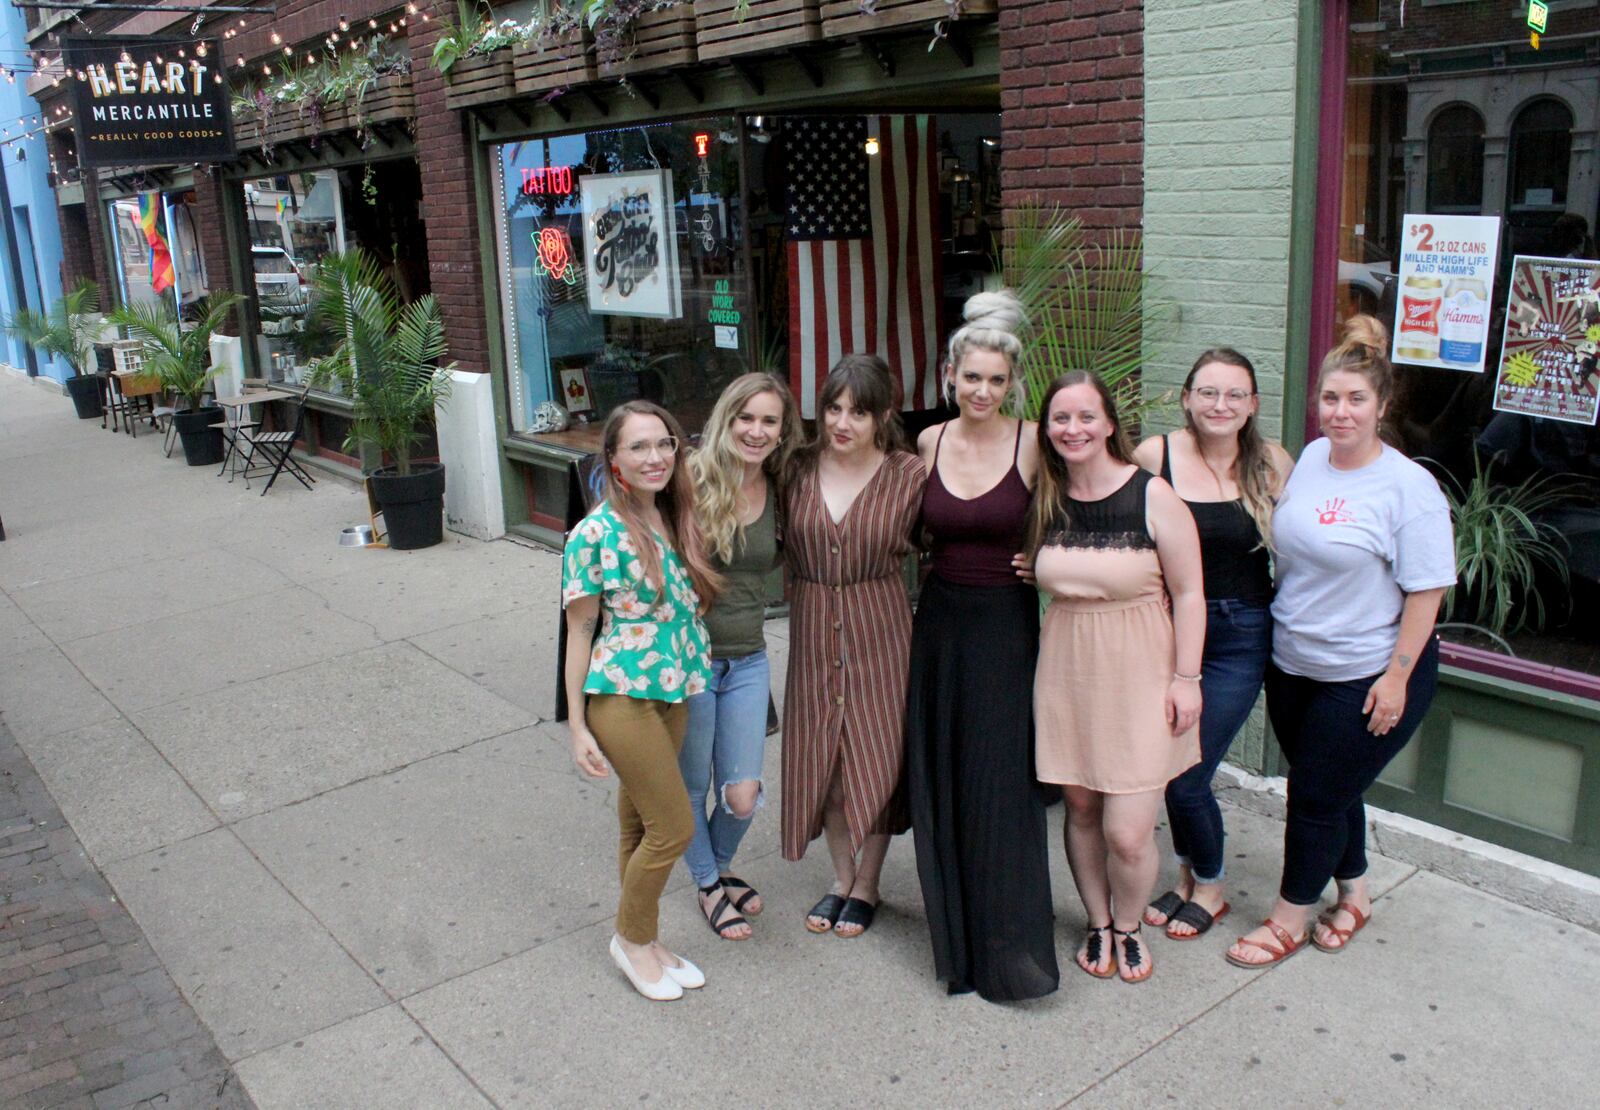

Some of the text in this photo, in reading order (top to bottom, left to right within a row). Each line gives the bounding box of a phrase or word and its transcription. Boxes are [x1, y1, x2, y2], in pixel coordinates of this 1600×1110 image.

[86, 61, 207, 98] HEART
[92, 104, 213, 121] MERCANTILE
[98, 130, 215, 141] REALLY GOOD GOODS
[520, 166, 572, 194] TATTOO
[1435, 241, 1445, 253] 12
[1447, 241, 1460, 253] OZ
[1462, 242, 1487, 254] CANS
[1404, 253, 1489, 267] MILLER HIGH LIFE
[1415, 264, 1475, 276] AND HAMM'S
[715, 280, 729, 294] OLD
[712, 295, 734, 309] WORK
[708, 309, 740, 324] COVERED
[1404, 318, 1435, 328] HIGH LIFE
